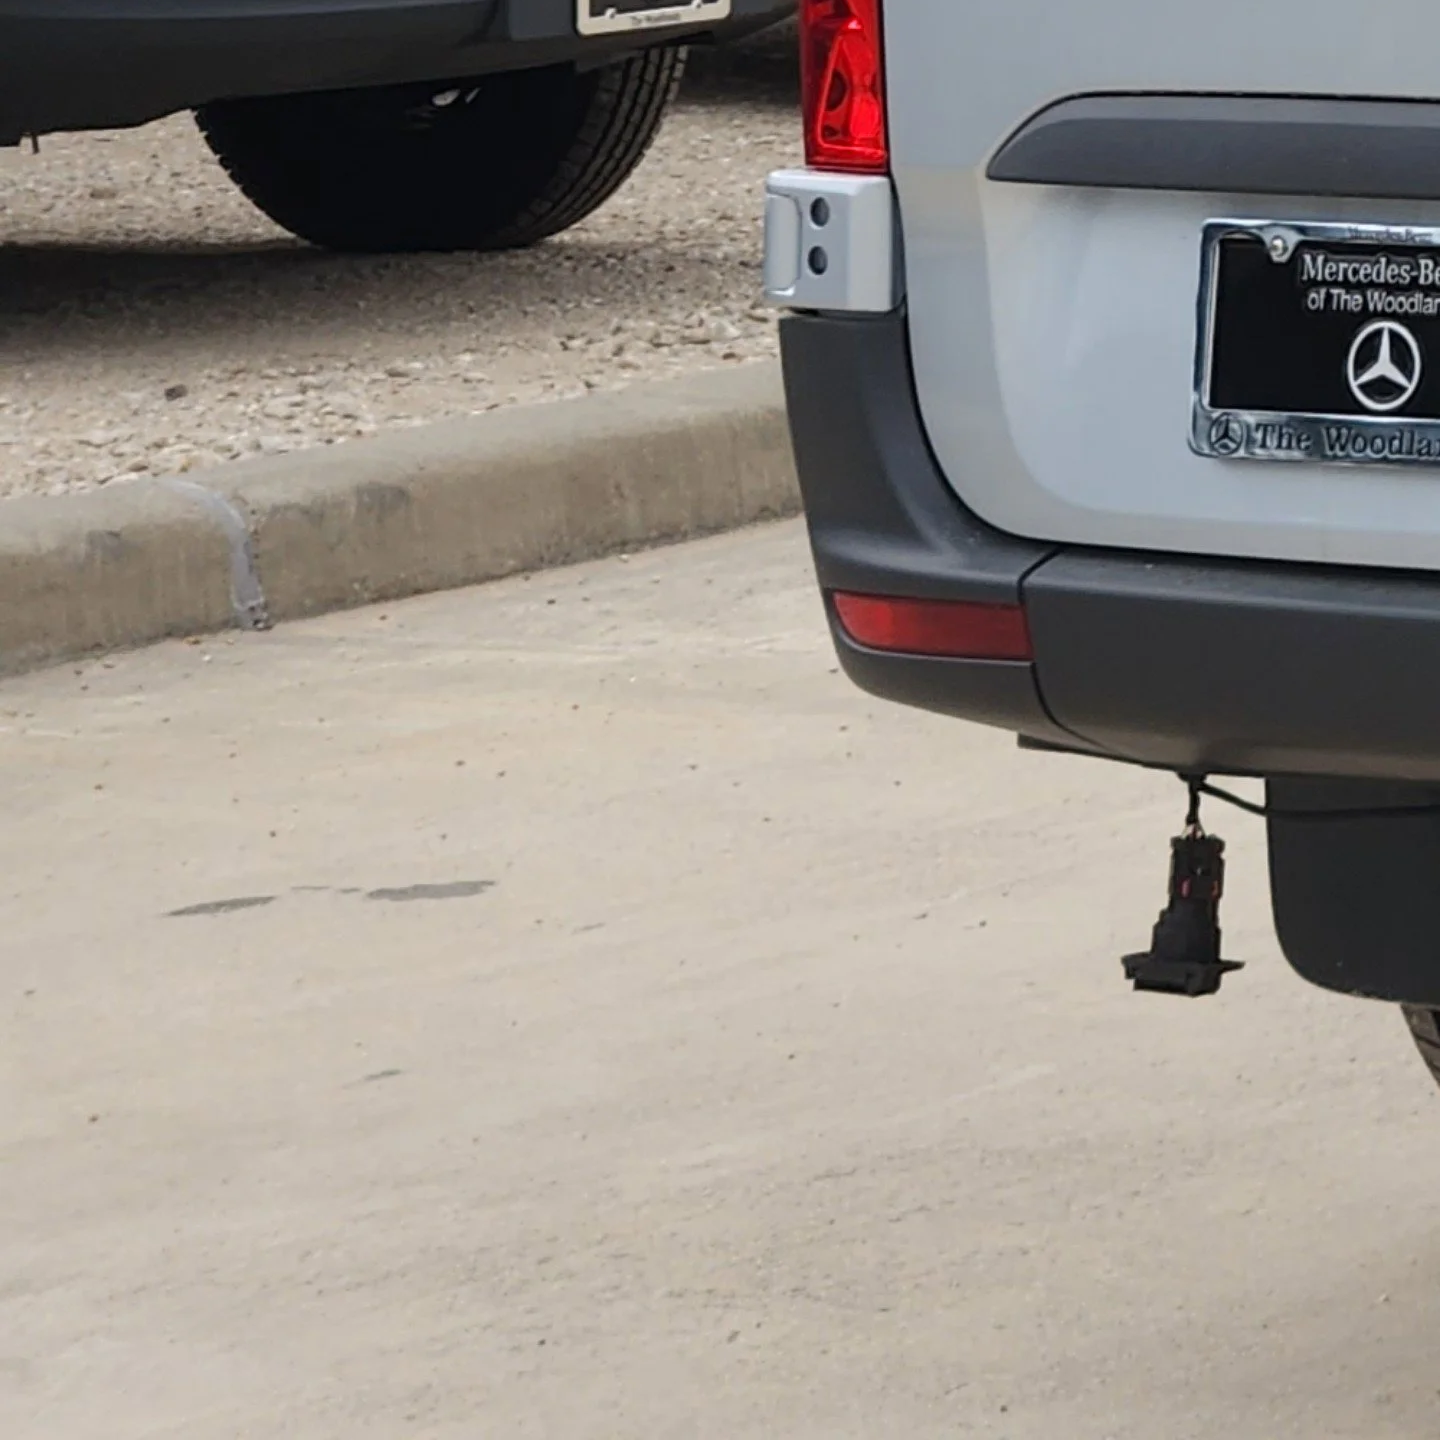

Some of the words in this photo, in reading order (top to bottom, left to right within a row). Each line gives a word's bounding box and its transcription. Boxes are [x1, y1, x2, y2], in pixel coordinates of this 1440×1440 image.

[1307, 289, 1328, 311] of
[1331, 289, 1363, 313] The
[1254, 423, 1311, 453] The
